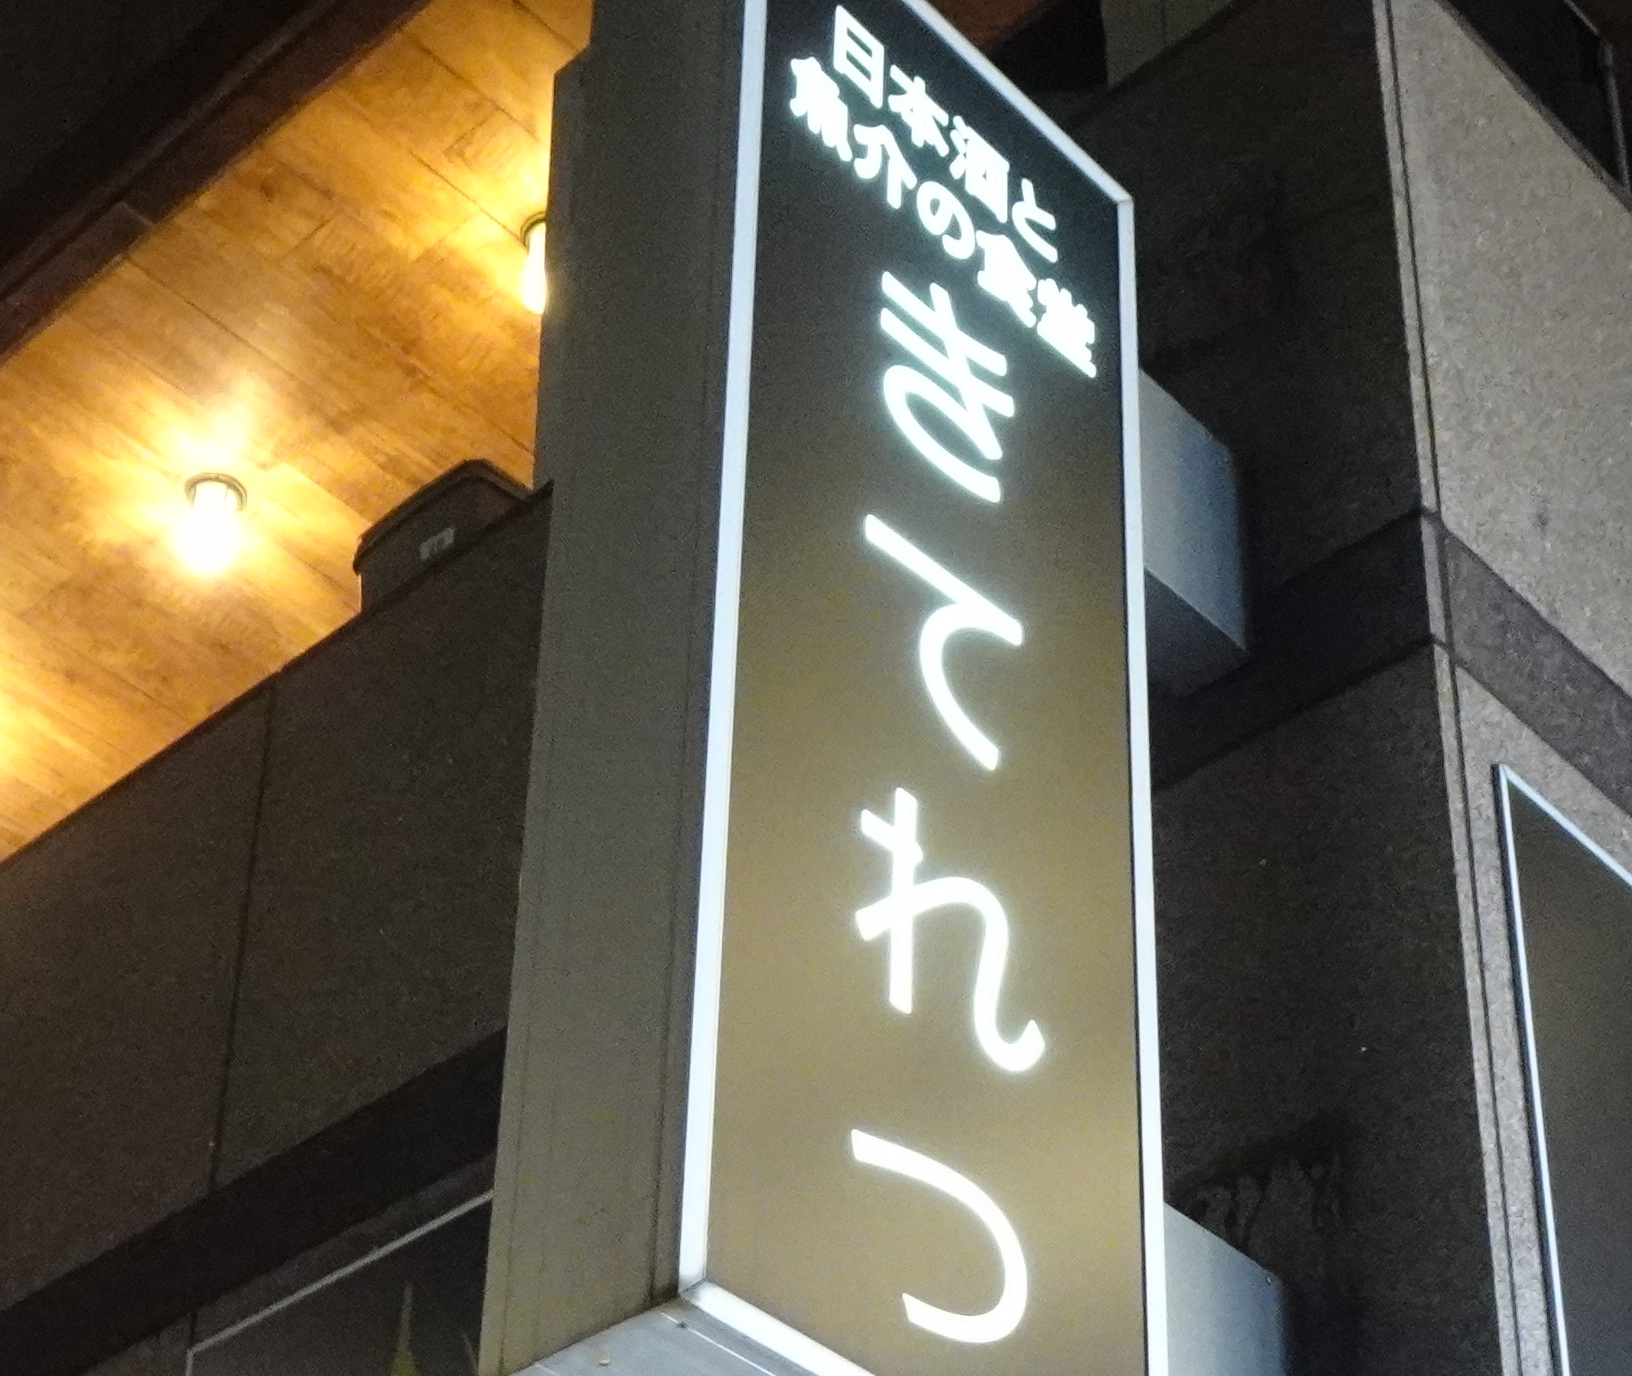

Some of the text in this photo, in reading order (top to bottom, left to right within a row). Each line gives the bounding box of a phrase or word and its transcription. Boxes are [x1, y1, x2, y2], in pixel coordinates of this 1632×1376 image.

[789, 56, 1097, 379] 魚介の食堂
[832, 4, 1058, 263] 日本酒と
[850, 271, 1046, 1345] きてれつ
